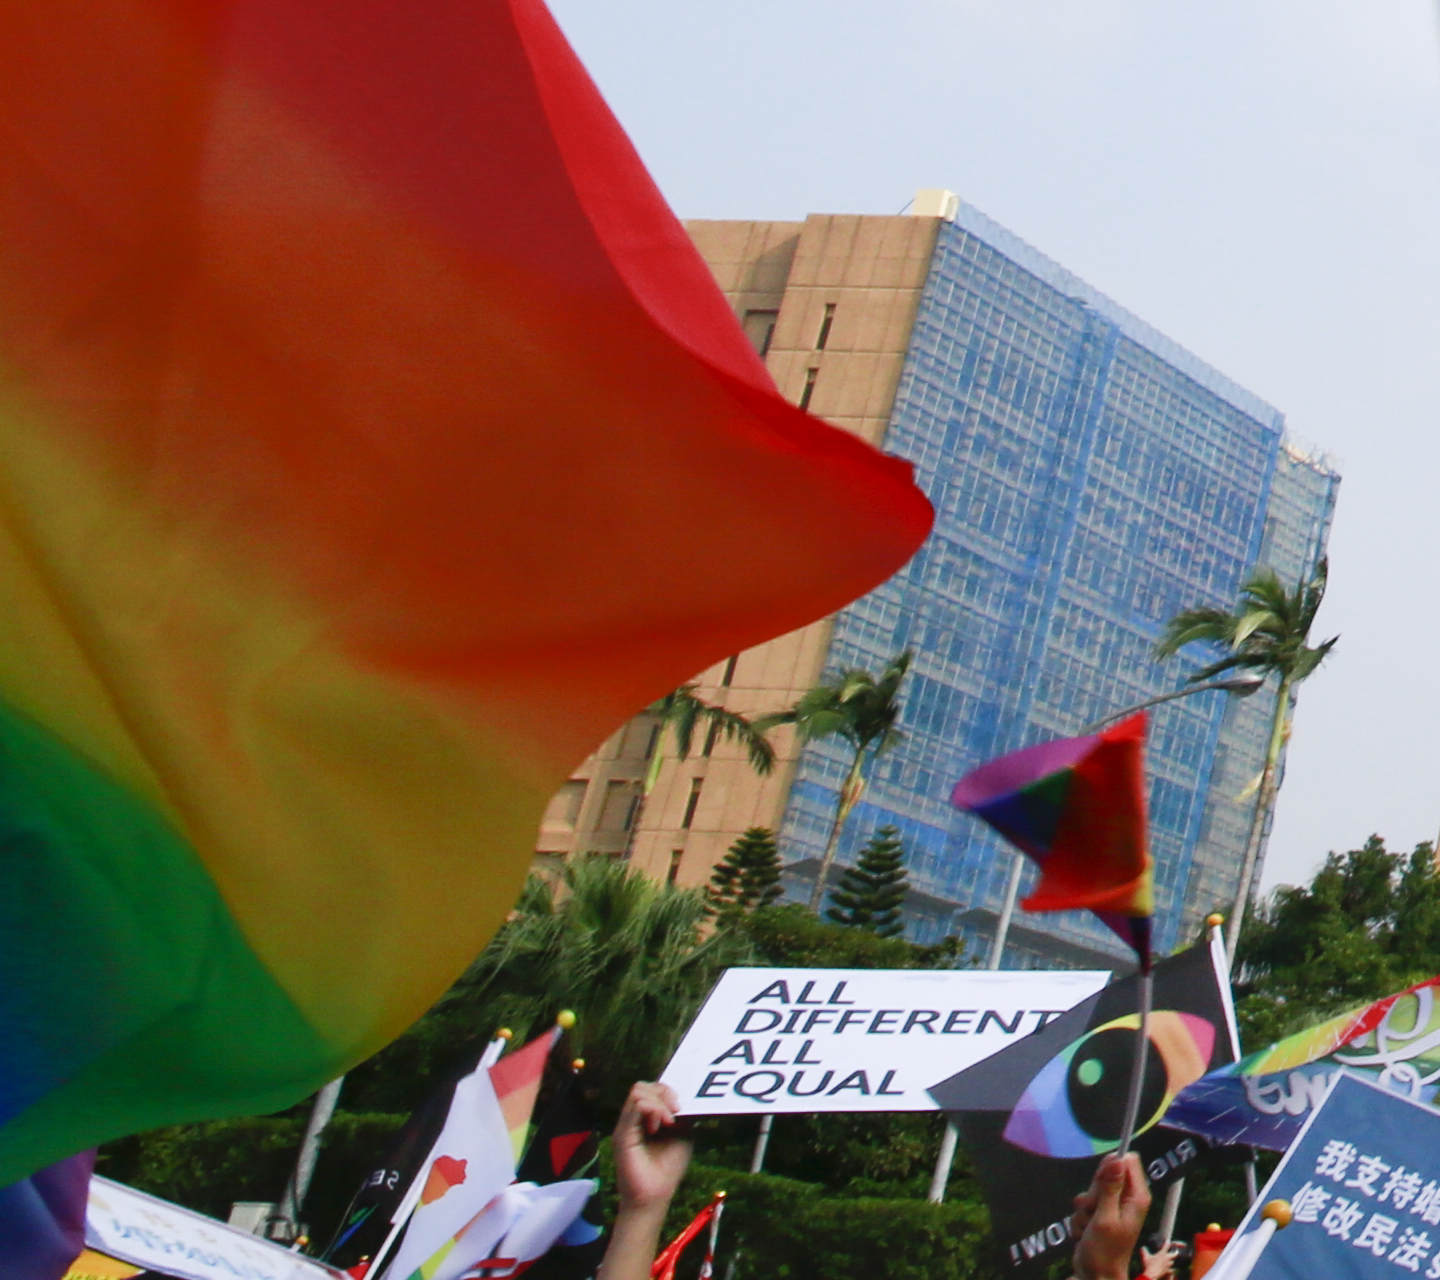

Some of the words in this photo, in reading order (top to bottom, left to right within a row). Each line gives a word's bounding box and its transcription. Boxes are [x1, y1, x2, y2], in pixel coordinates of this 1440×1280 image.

[746, 979, 855, 1005] ALL
[733, 1009, 1069, 1035] DIFFERENT
[709, 1039, 822, 1066] ALL
[694, 1069, 906, 1103] EQUAL
